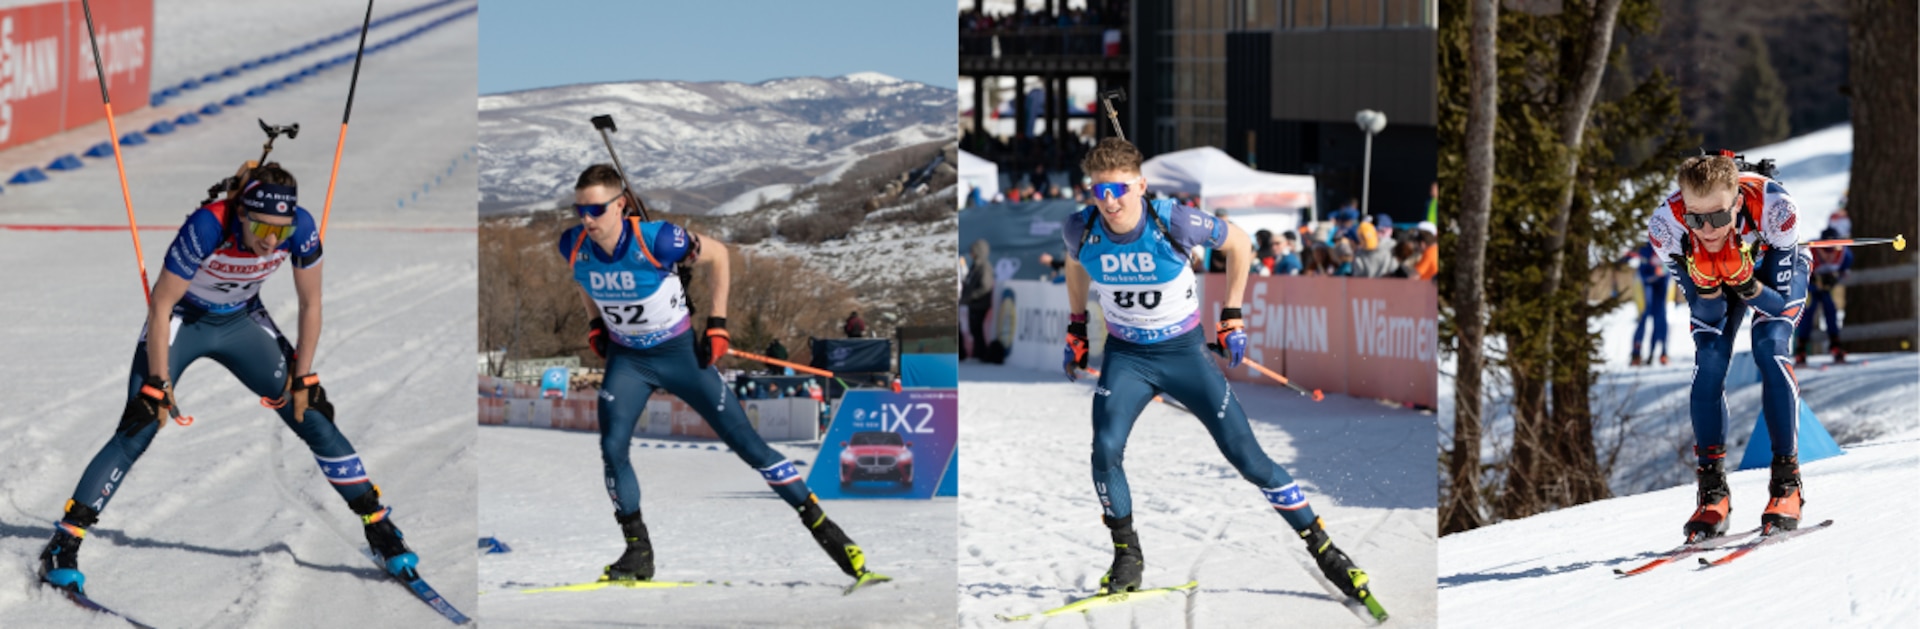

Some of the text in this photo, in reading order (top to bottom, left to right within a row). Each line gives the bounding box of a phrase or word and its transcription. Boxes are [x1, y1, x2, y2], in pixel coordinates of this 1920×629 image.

[1101, 252, 1156, 272] DKB
[589, 271, 637, 290] DKB
[603, 305, 648, 325] 52
[881, 403, 934, 433] iX2
[92, 467, 123, 511] USA
